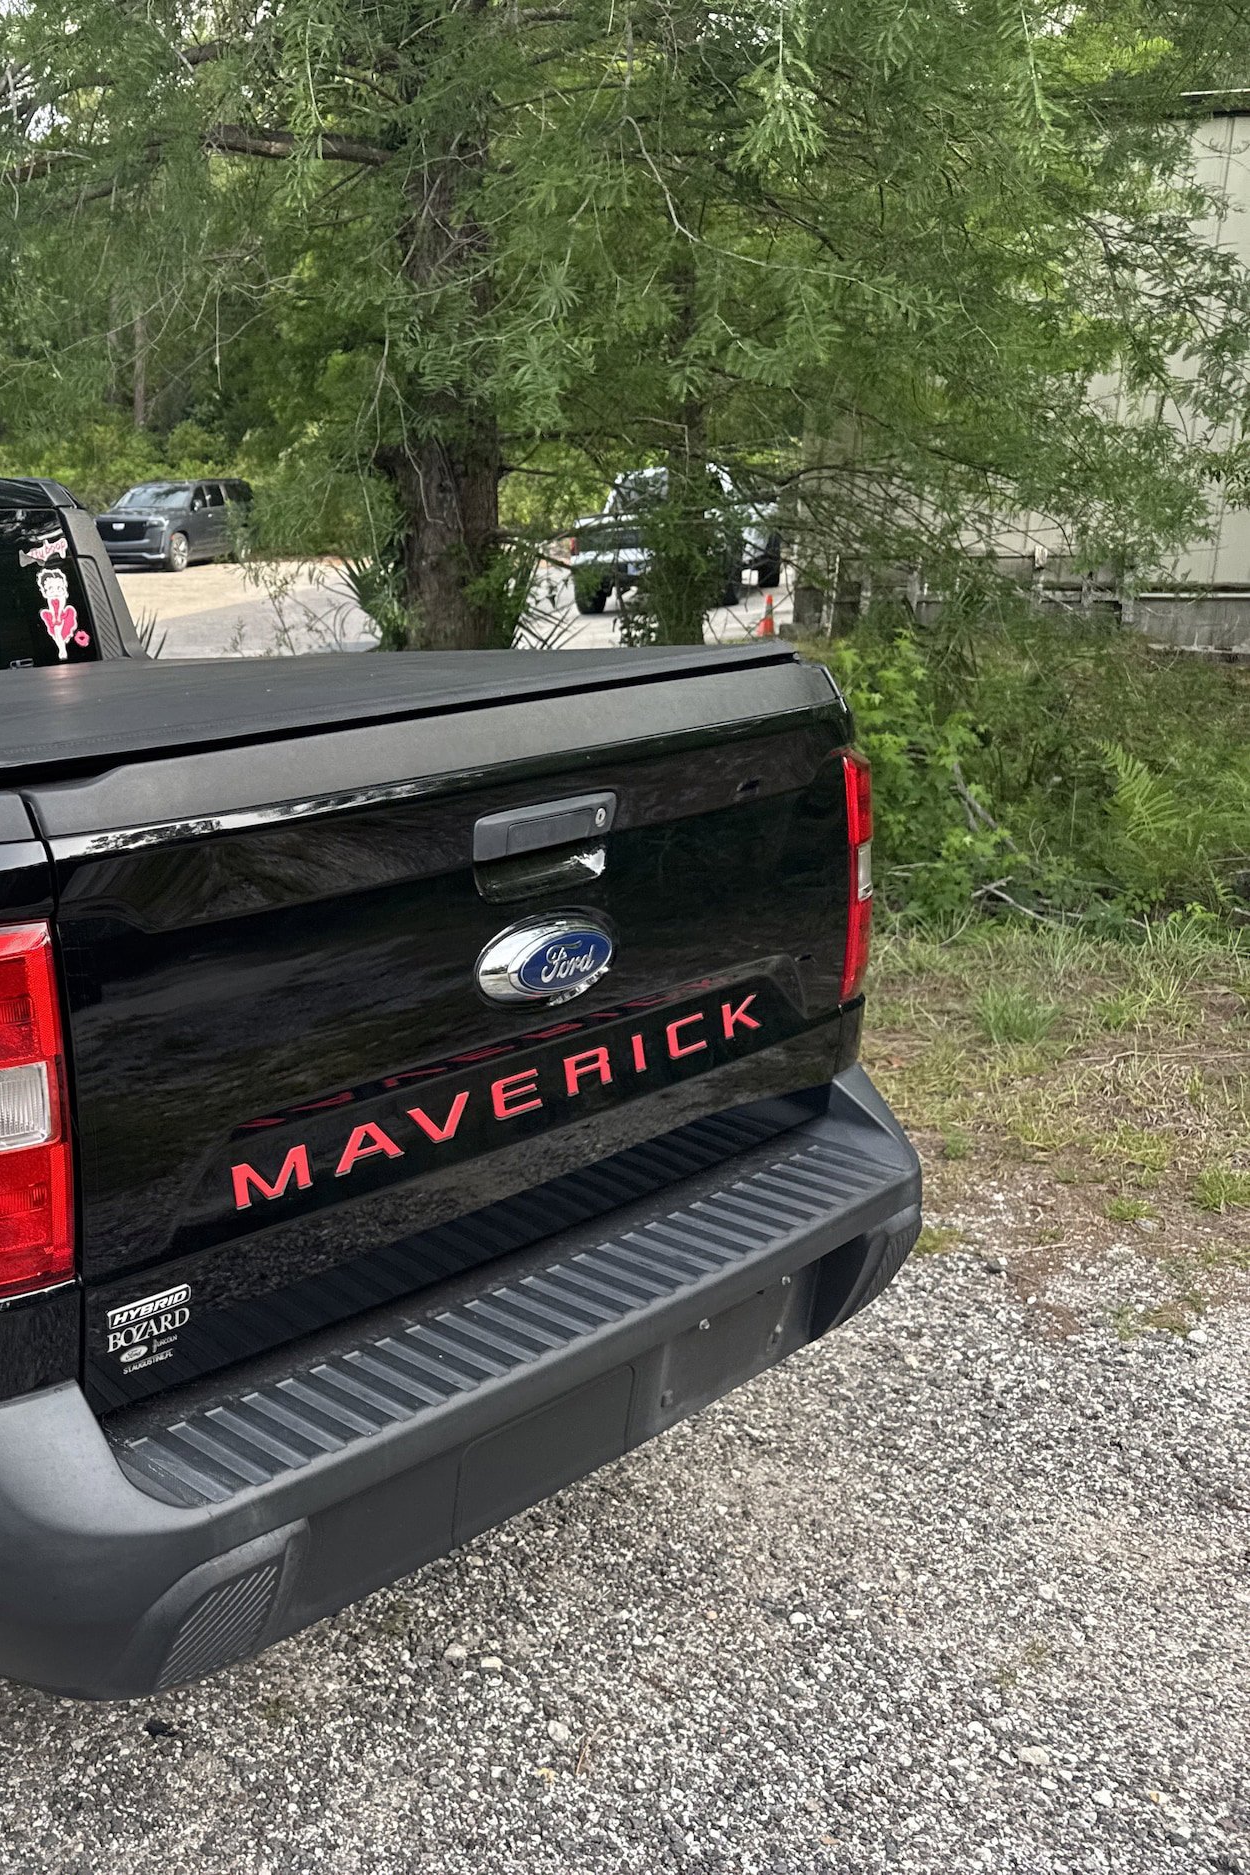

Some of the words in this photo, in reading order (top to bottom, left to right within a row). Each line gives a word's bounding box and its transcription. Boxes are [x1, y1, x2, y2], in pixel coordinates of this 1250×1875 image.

[540, 940, 597, 984] Ford
[230, 994, 762, 1210] MAVERICK
[107, 1307, 190, 1353] BOZARD
[113, 1290, 188, 1326] HYBRID
